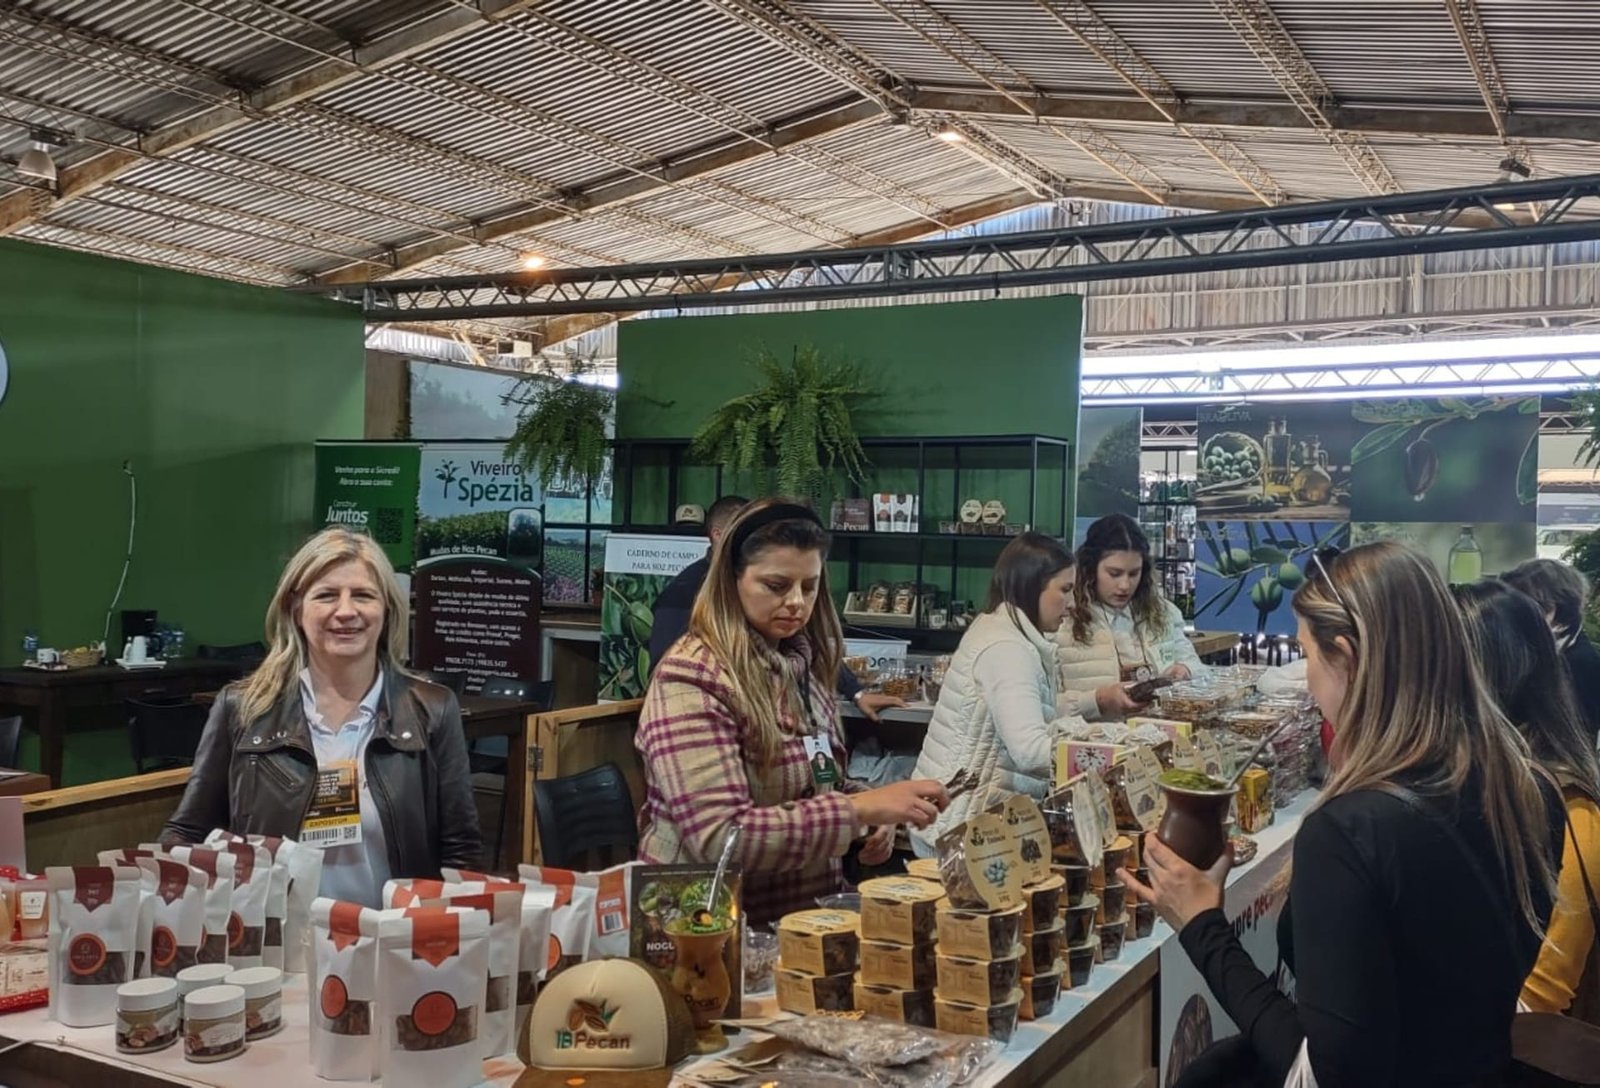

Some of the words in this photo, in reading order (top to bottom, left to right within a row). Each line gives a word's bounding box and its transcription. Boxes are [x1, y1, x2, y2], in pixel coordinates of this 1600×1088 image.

[471, 460, 521, 475] Viveiro
[458, 477, 533, 507] Spézia
[326, 506, 369, 523] Juntos
[627, 549, 660, 558] CADERNO
[662, 550, 670, 558] DE
